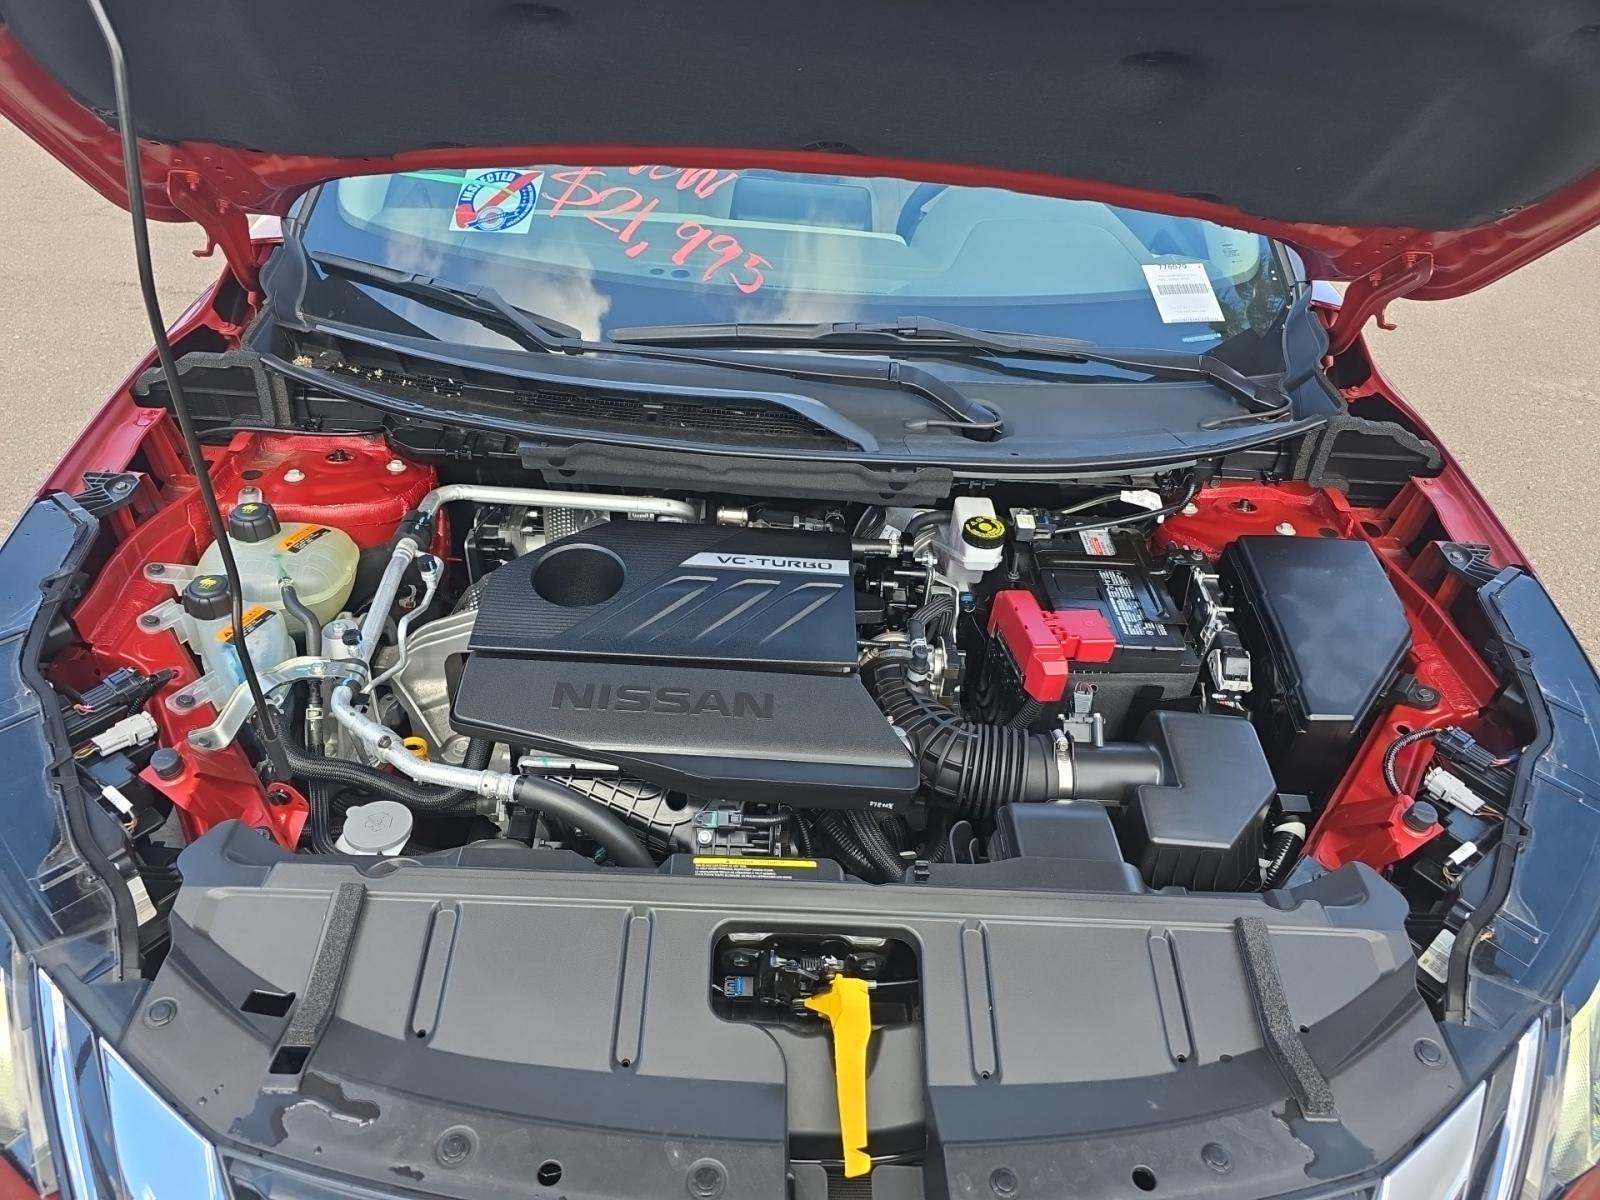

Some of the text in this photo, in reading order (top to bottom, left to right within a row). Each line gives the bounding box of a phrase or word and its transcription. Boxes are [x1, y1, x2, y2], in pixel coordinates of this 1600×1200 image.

[542, 166, 773, 294] $21,995
[717, 555, 832, 570] VC-TURBO
[552, 681, 775, 721] NISSAN
